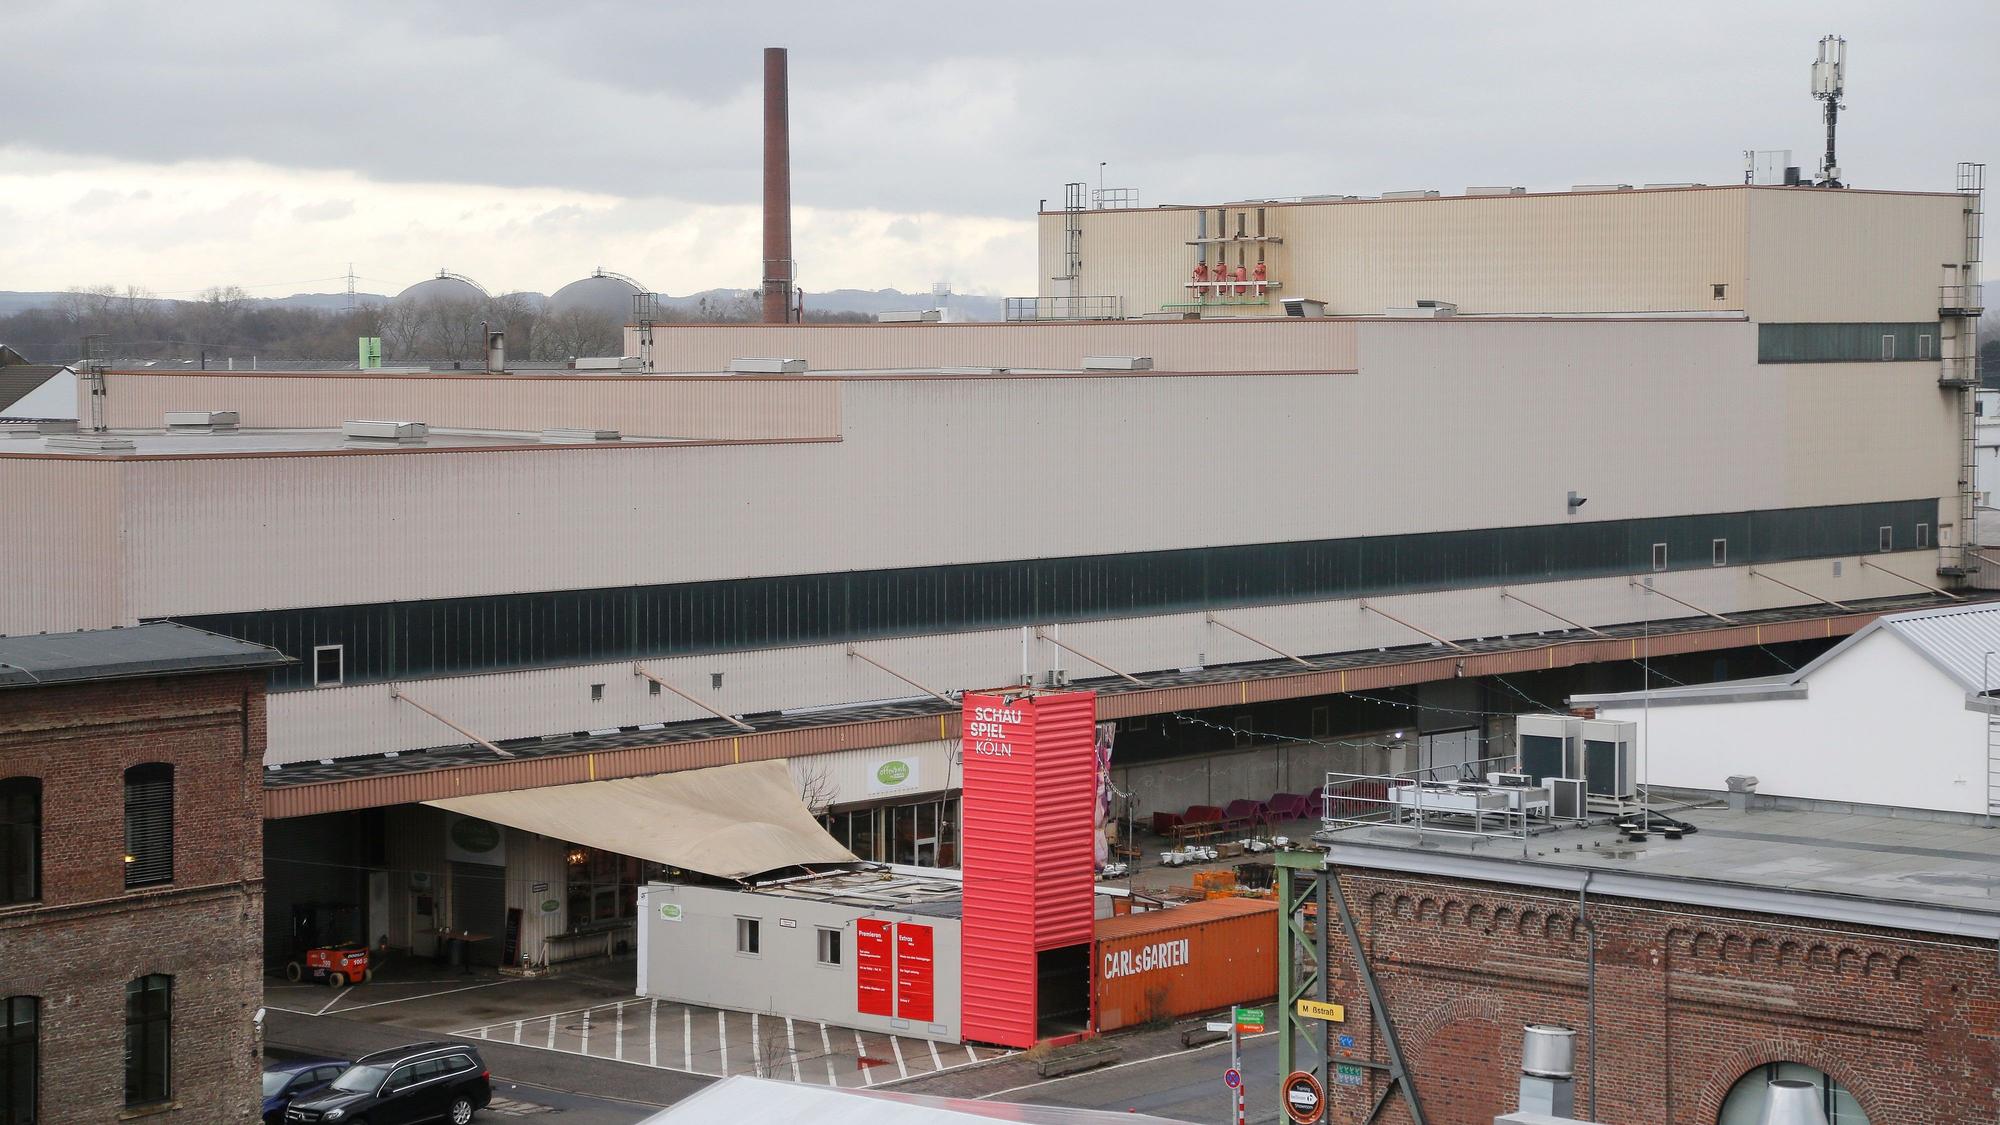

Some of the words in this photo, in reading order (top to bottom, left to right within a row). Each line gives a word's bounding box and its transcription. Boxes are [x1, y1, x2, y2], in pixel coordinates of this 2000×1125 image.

[975, 706, 1022, 724] SCHAU
[970, 722, 1006, 739] SPIEL
[975, 738, 1012, 757] KÖLN
[858, 930, 882, 939] Premieren
[898, 934, 913, 942] Extras
